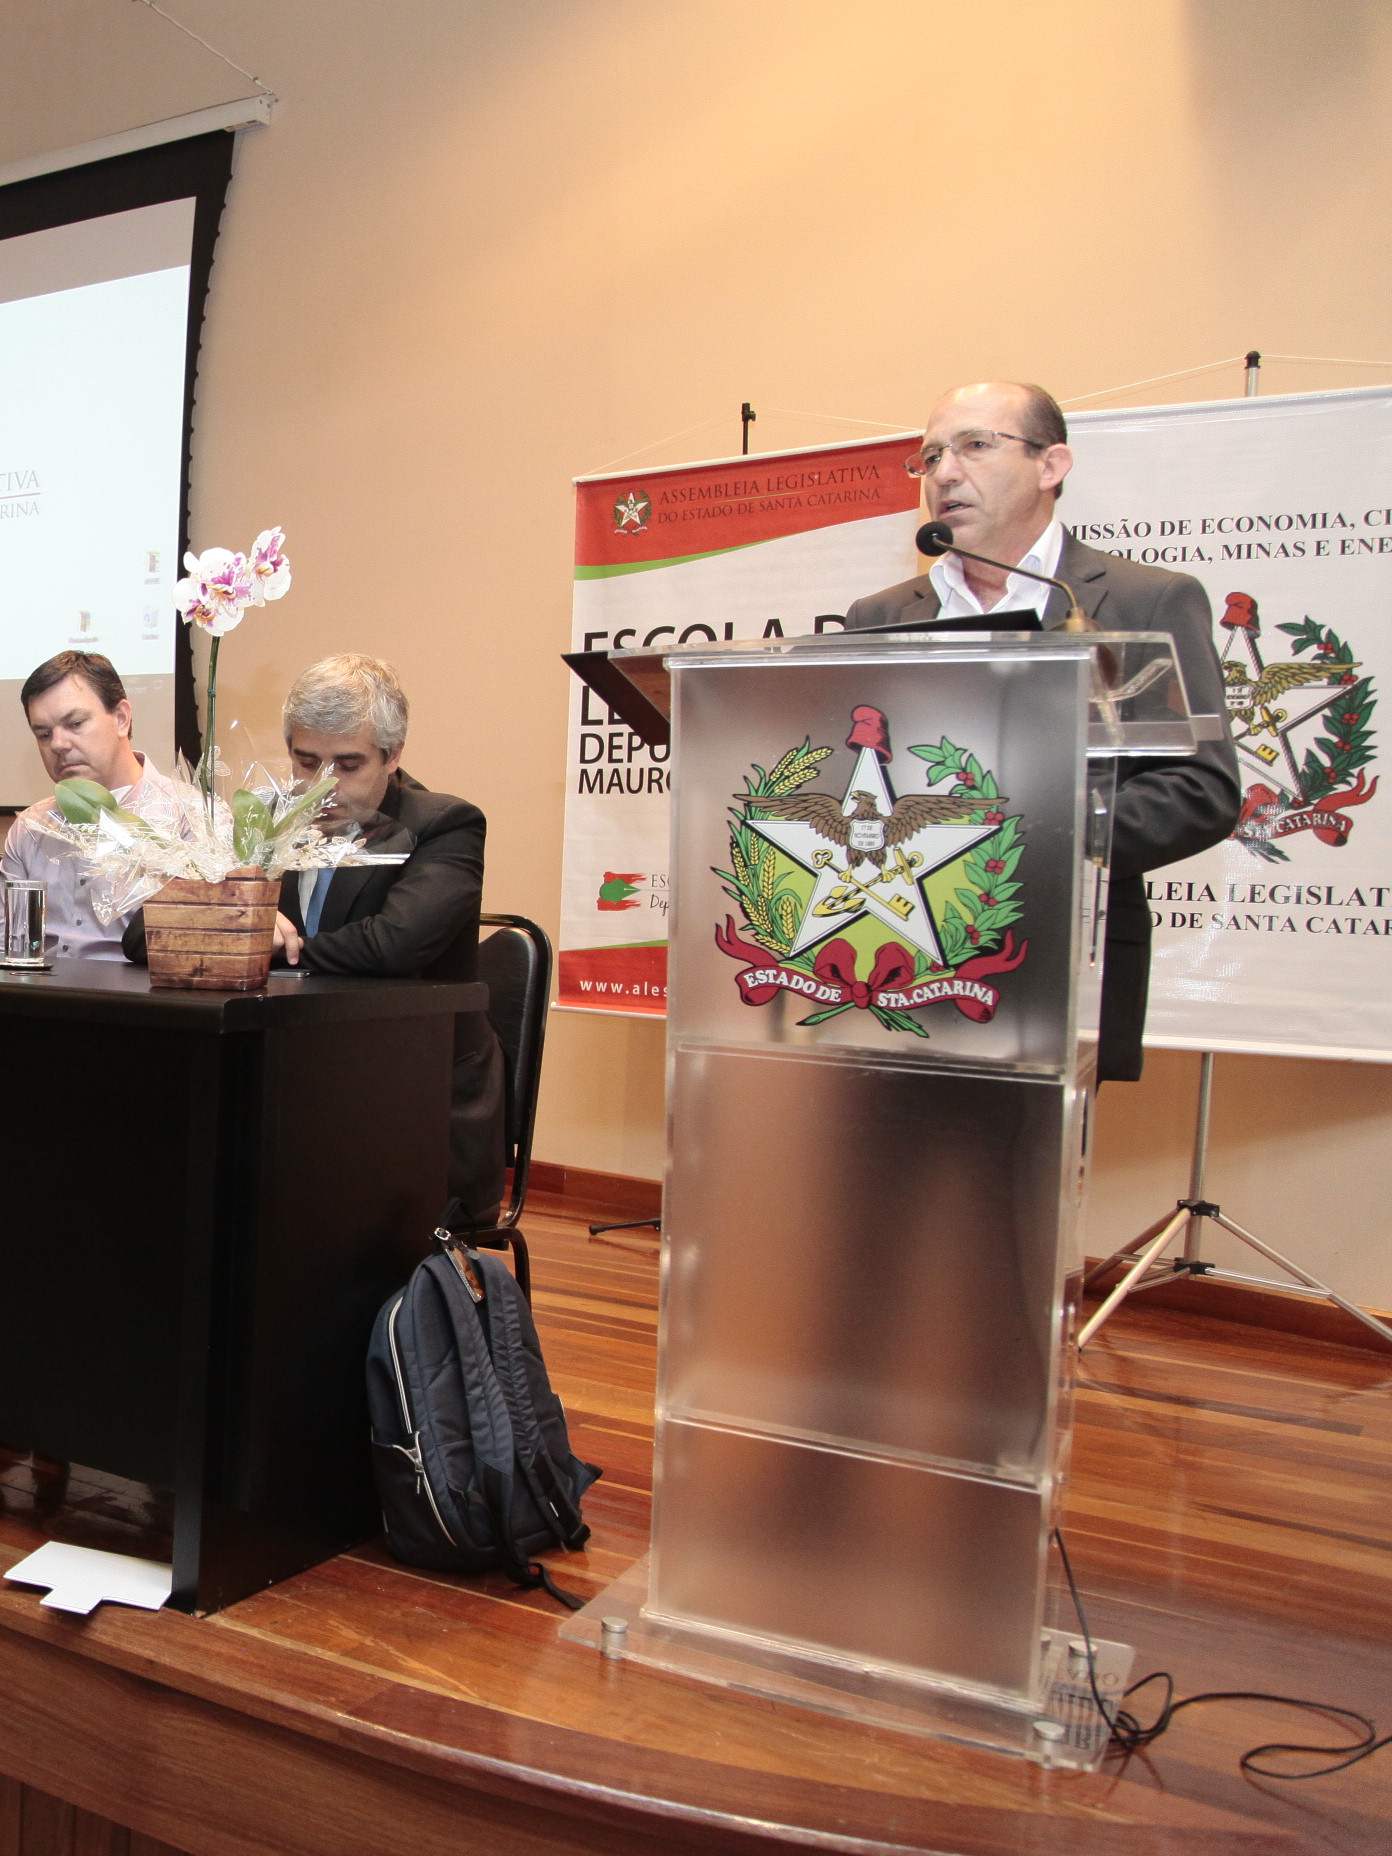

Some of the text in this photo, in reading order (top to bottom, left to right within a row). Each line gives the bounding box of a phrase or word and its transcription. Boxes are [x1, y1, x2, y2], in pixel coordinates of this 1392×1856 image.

[660, 464, 881, 505] ASSEMBLEIA LEGISLATIVA
[658, 487, 881, 524] DO ESTADO DE SANTA CATARINA
[1158, 519, 1192, 537] DE
[1200, 511, 1356, 535] ECONOMIA,
[1220, 541, 1306, 561] MINAS
[1313, 539, 1330, 557] E
[1338, 536, 1392, 556] ENE
[578, 767, 671, 794] MAUR
[1145, 881, 1217, 902] LEIA
[1170, 911, 1203, 929] DE
[1211, 912, 1298, 933] SANTA
[743, 969, 815, 994] ESTADO
[815, 985, 842, 1003] DE
